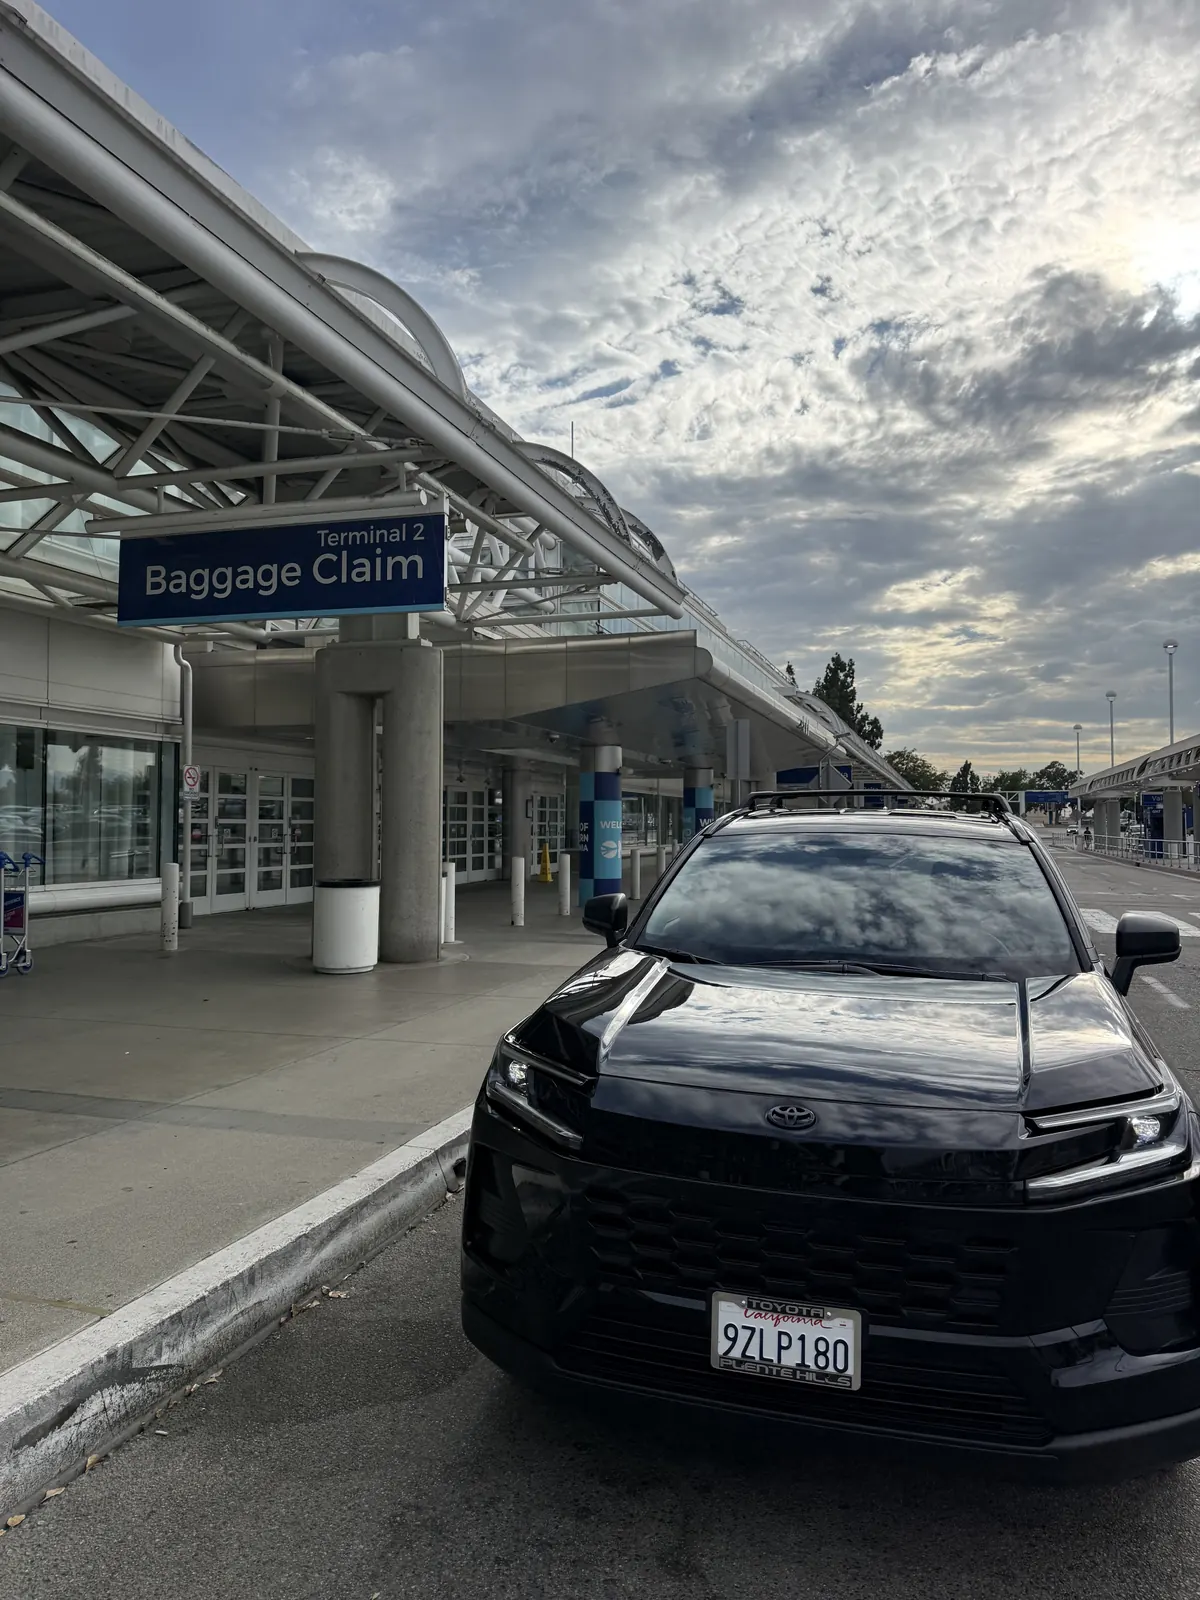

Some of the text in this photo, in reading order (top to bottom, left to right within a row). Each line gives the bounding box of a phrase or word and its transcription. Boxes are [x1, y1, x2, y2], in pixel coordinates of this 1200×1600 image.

[317, 523, 425, 547] Terminal 2
[146, 548, 424, 600] Baggage Claim
[749, 1300, 824, 1317] TOYOTA
[722, 1322, 849, 1374] 9ZLP180
[720, 1358, 851, 1387] PUENTE HILLS
